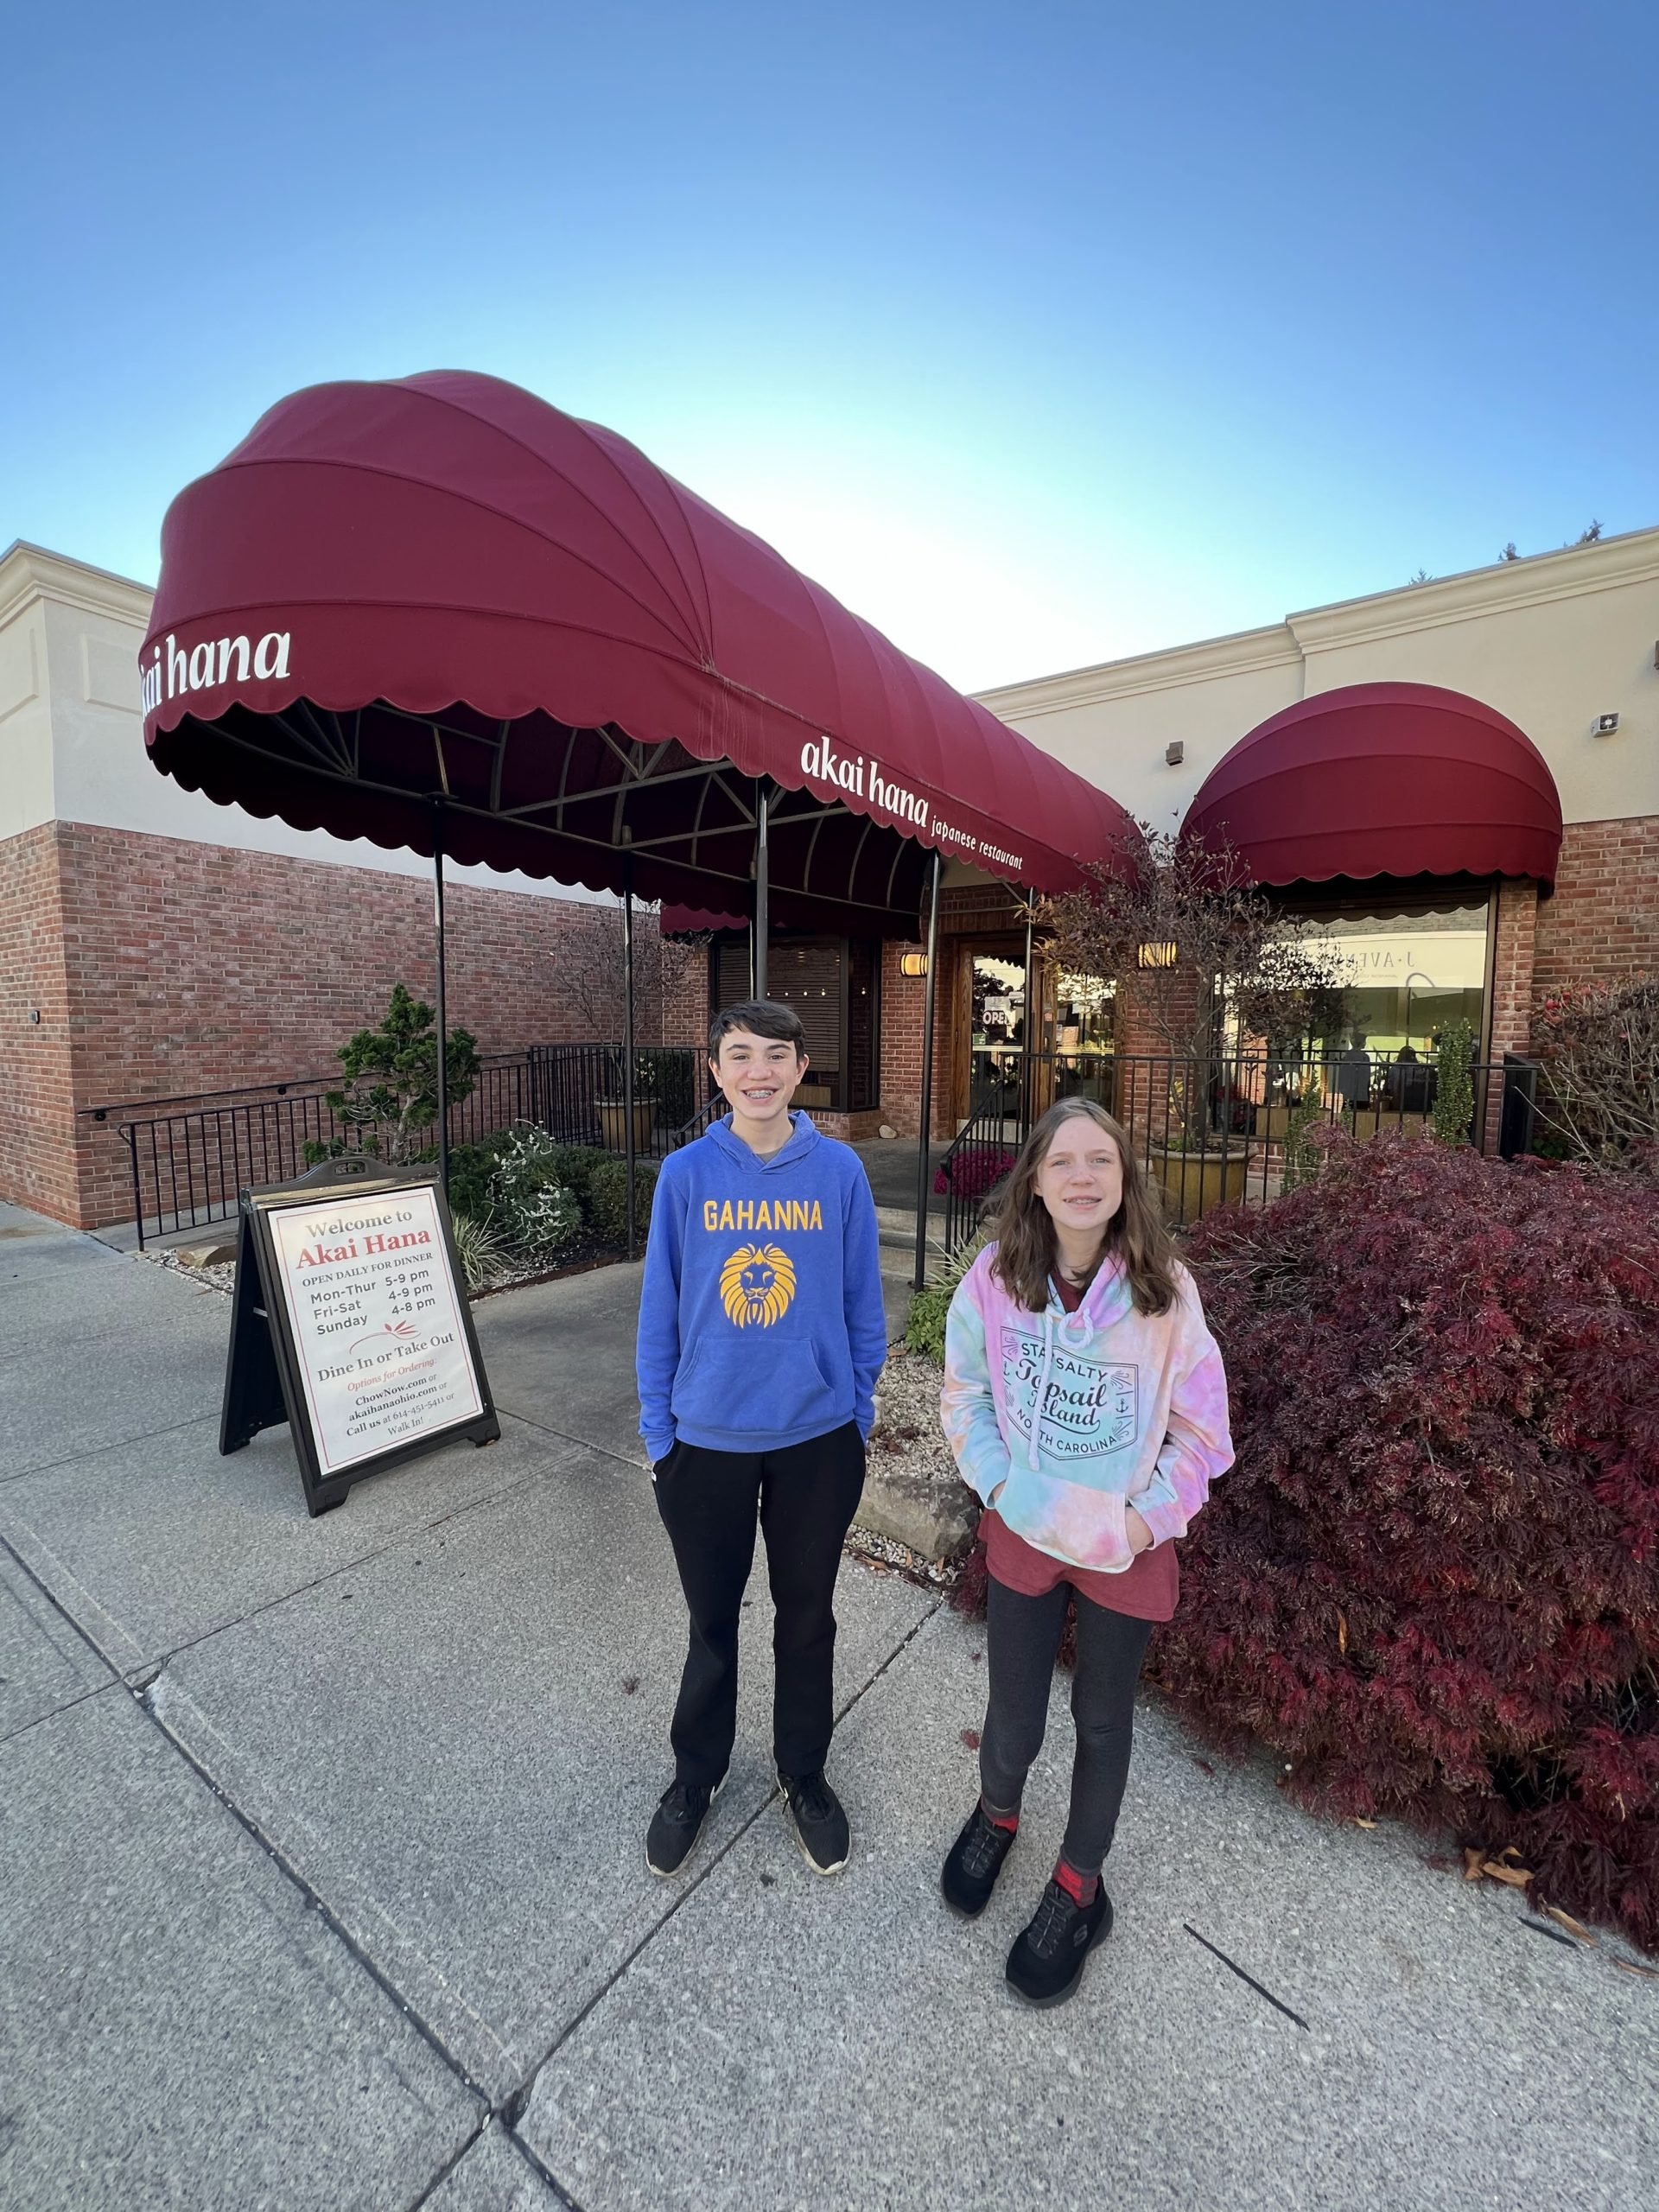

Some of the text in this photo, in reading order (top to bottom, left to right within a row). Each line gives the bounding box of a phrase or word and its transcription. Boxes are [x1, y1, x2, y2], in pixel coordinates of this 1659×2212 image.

[166, 632, 290, 699] hana
[800, 735, 1023, 871] akai hana japanese restaurant
[305, 1211, 412, 1238] Welcome to
[703, 1198, 823, 1231] GAHANNA
[296, 1230, 431, 1269] Akai Hana
[302, 1252, 433, 1287] OPEN DAILY FOR DINNER
[310, 1269, 429, 1304] Mon-Thur 5-9 pm
[314, 1283, 433, 1319] Fri-Sat 4-9 pm
[317, 1298, 435, 1335] Sunday 4-8 pm
[318, 1332, 454, 1382] Dine In or Take Out
[347, 1358, 437, 1392] Options for Ordering:
[1021, 1342, 1109, 1382] STA SALTY
[348, 1386, 437, 1421] akaihanaohio.com
[355, 1376, 427, 1406] ChowNow.com
[346, 1424, 367, 1437] Call
[392, 1397, 445, 1421] 614-451-5411
[388, 1422, 410, 1436] Walk
[1017, 1408, 1117, 1453] NOTH CAROLINA
